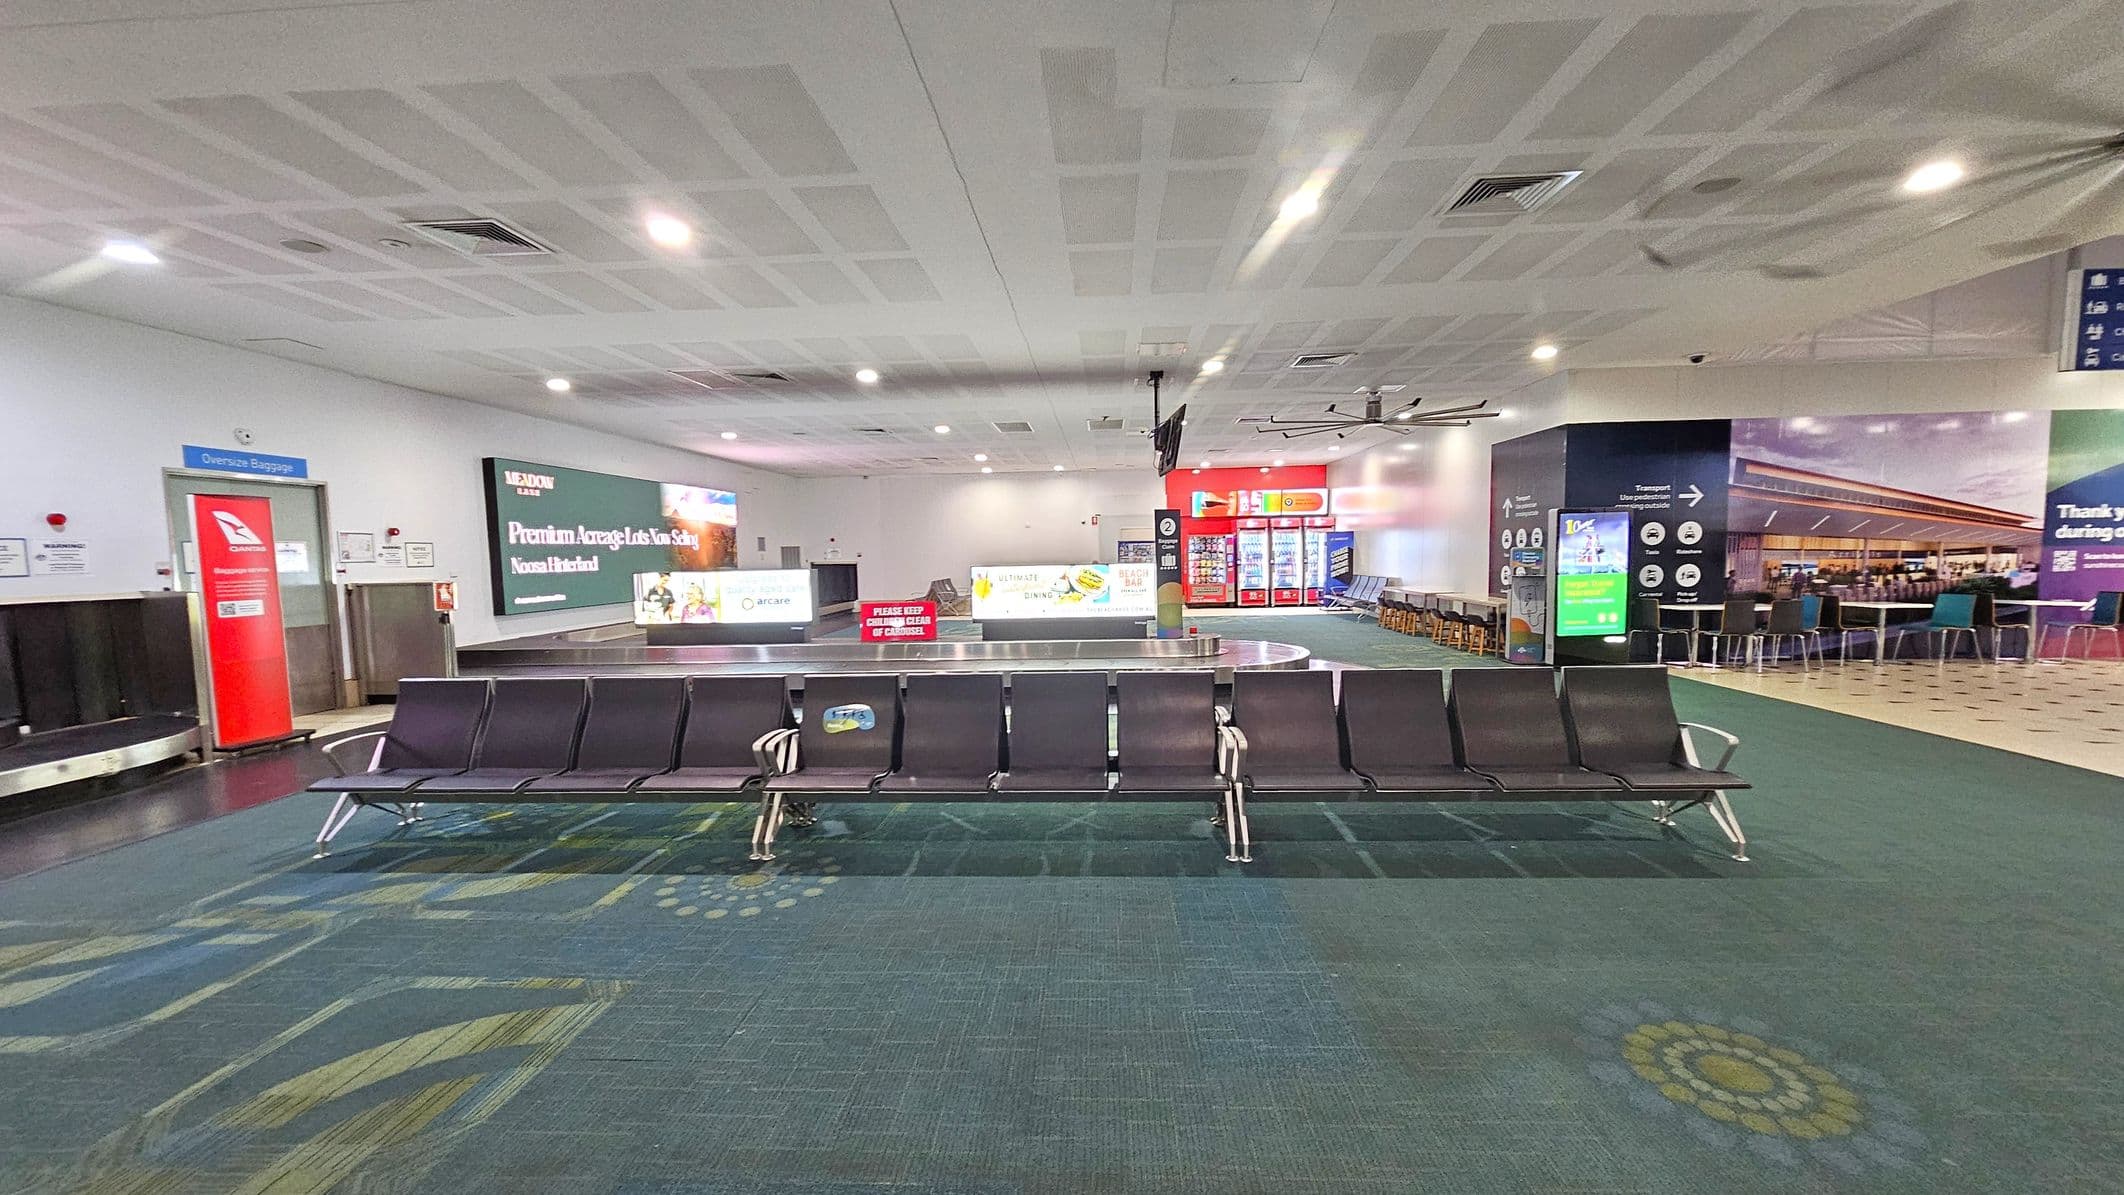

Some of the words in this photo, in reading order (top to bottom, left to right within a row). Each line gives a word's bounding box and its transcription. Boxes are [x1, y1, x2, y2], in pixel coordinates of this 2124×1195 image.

[201, 453, 249, 468] Oversize
[250, 458, 294, 474] Baggage
[504, 470, 555, 490] MEADOW
[1634, 484, 1671, 493] Transport
[1634, 493, 1671, 502] pedestrian
[2056, 503, 2113, 519] Thank
[508, 521, 575, 545] Premium
[575, 525, 625, 551] Acreage
[624, 526, 650, 546] Lots
[648, 528, 672, 546] Now
[2055, 524, 2113, 542] during
[511, 556, 548, 575] Noosa
[546, 555, 600, 574] Hinterland
[998, 573, 1039, 583] ULTIMATE
[1119, 568, 1149, 578] BEACH
[1124, 577, 1144, 587] BAR
[1024, 590, 1054, 600] DINING
[757, 597, 791, 605] arcare
[873, 606, 903, 617] PLEASE
[903, 605, 925, 616] KEEP
[905, 615, 932, 626] CLEAR
[872, 628, 885, 638] OF
[884, 626, 926, 637] CAROUSEL
